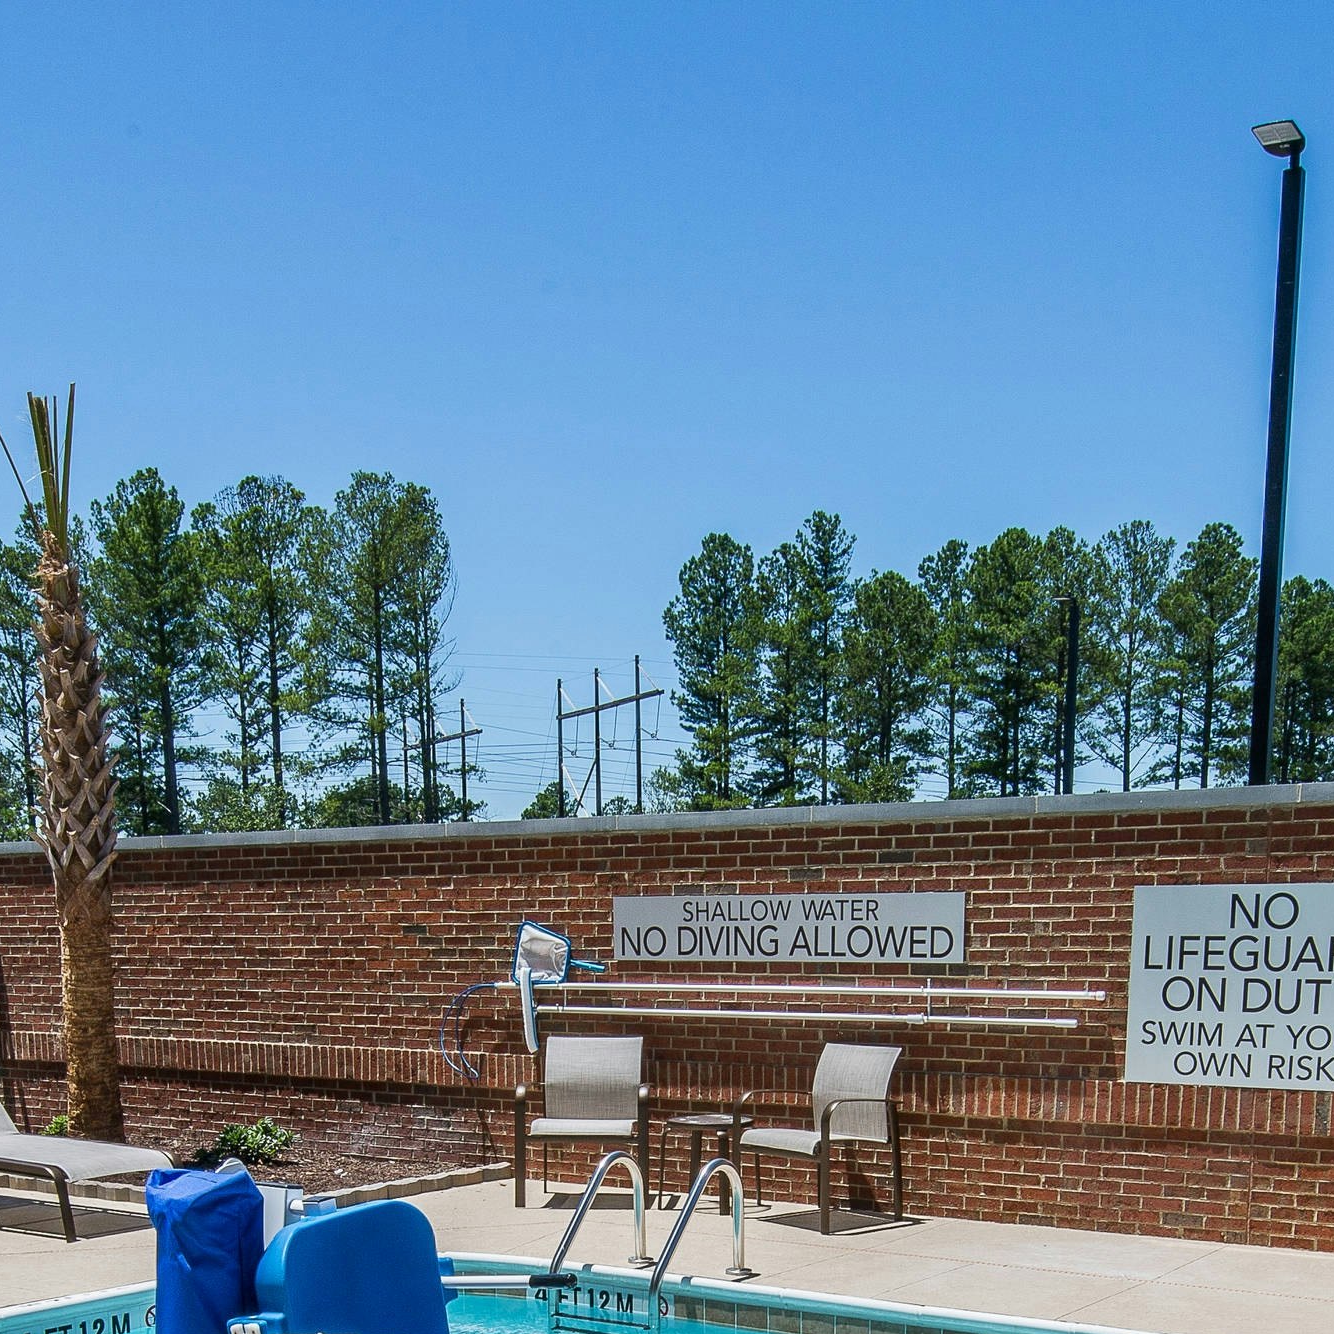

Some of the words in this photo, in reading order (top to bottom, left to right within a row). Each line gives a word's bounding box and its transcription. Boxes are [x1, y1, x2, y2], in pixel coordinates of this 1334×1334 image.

[682, 899, 792, 923] SHALLOW
[801, 899, 880, 922] WATER
[1229, 892, 1300, 930] NO
[620, 925, 668, 957] NO
[677, 924, 779, 957] DIVING
[788, 924, 955, 959] ALLOWED
[1161, 975, 1227, 1013] ON
[1141, 1020, 1223, 1047] SWIM
[1234, 1023, 1275, 1049] AT
[1173, 1051, 1252, 1078] OWN
[616, 1291, 634, 1314] M
